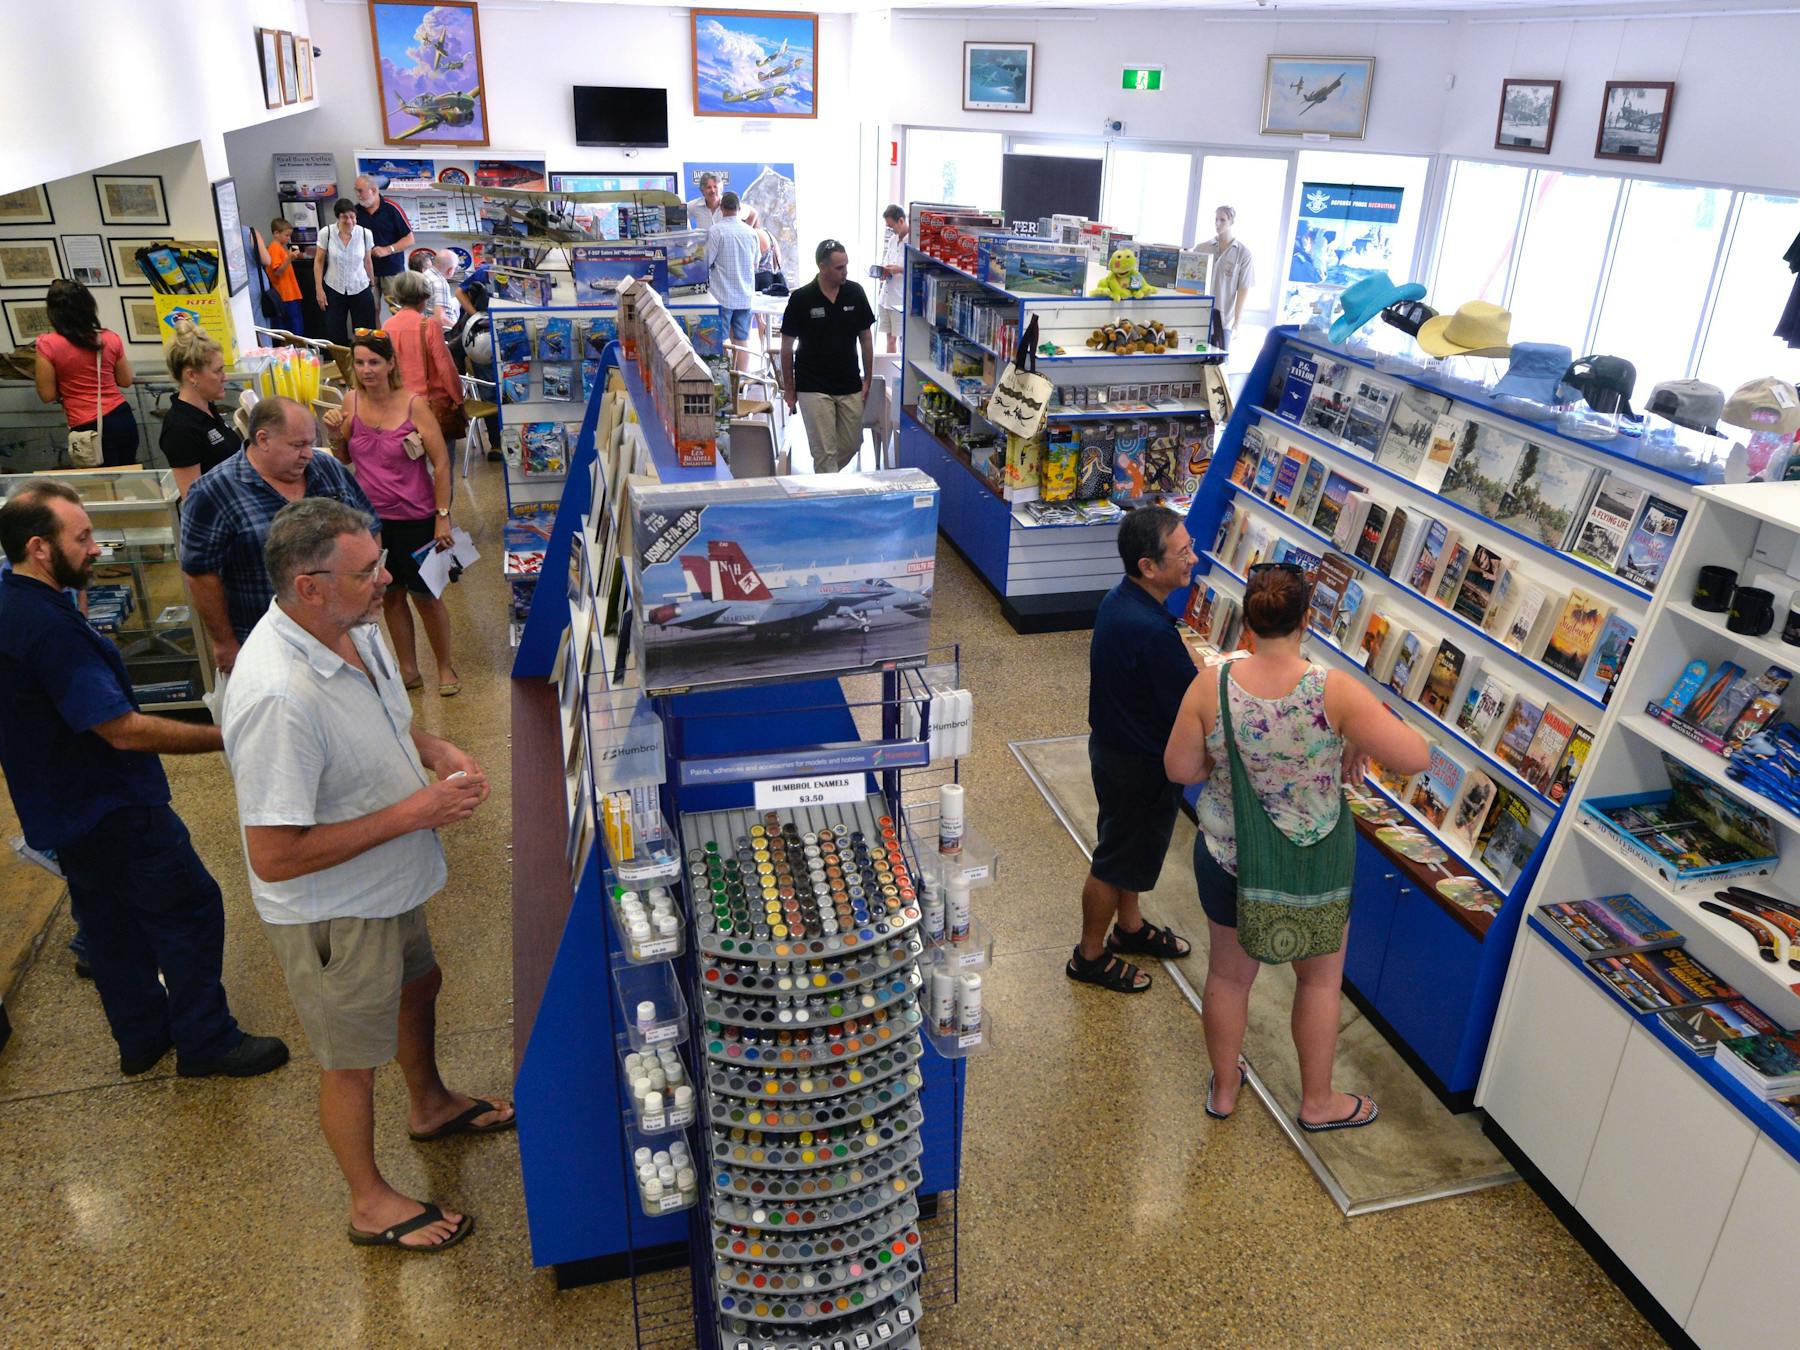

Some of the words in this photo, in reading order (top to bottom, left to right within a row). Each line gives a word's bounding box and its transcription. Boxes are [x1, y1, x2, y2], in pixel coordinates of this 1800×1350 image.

[1298, 361, 1310, 372] P.G.
[1290, 367, 1315, 382] TAYLOR
[648, 515, 668, 533] 1/32
[1598, 511, 1617, 525] FLYING
[1617, 519, 1630, 531] LIFE
[644, 538, 671, 563] USMC
[719, 560, 728, 572] N
[1296, 557, 1320, 574] VETS
[932, 720, 968, 731] Humbrol
[618, 744, 658, 757] Humbrol
[690, 767, 711, 777] Paints,
[712, 765, 745, 775] adhesives
[746, 764, 757, 772] and
[758, 761, 794, 771] accessories
[795, 760, 804, 768] for
[805, 758, 828, 767] models
[828, 757, 840, 765] and
[841, 755, 865, 764] hobbies
[772, 781, 812, 792] HUMBROL
[813, 779, 849, 790] ENAMELS
[799, 794, 824, 803] $3.50
